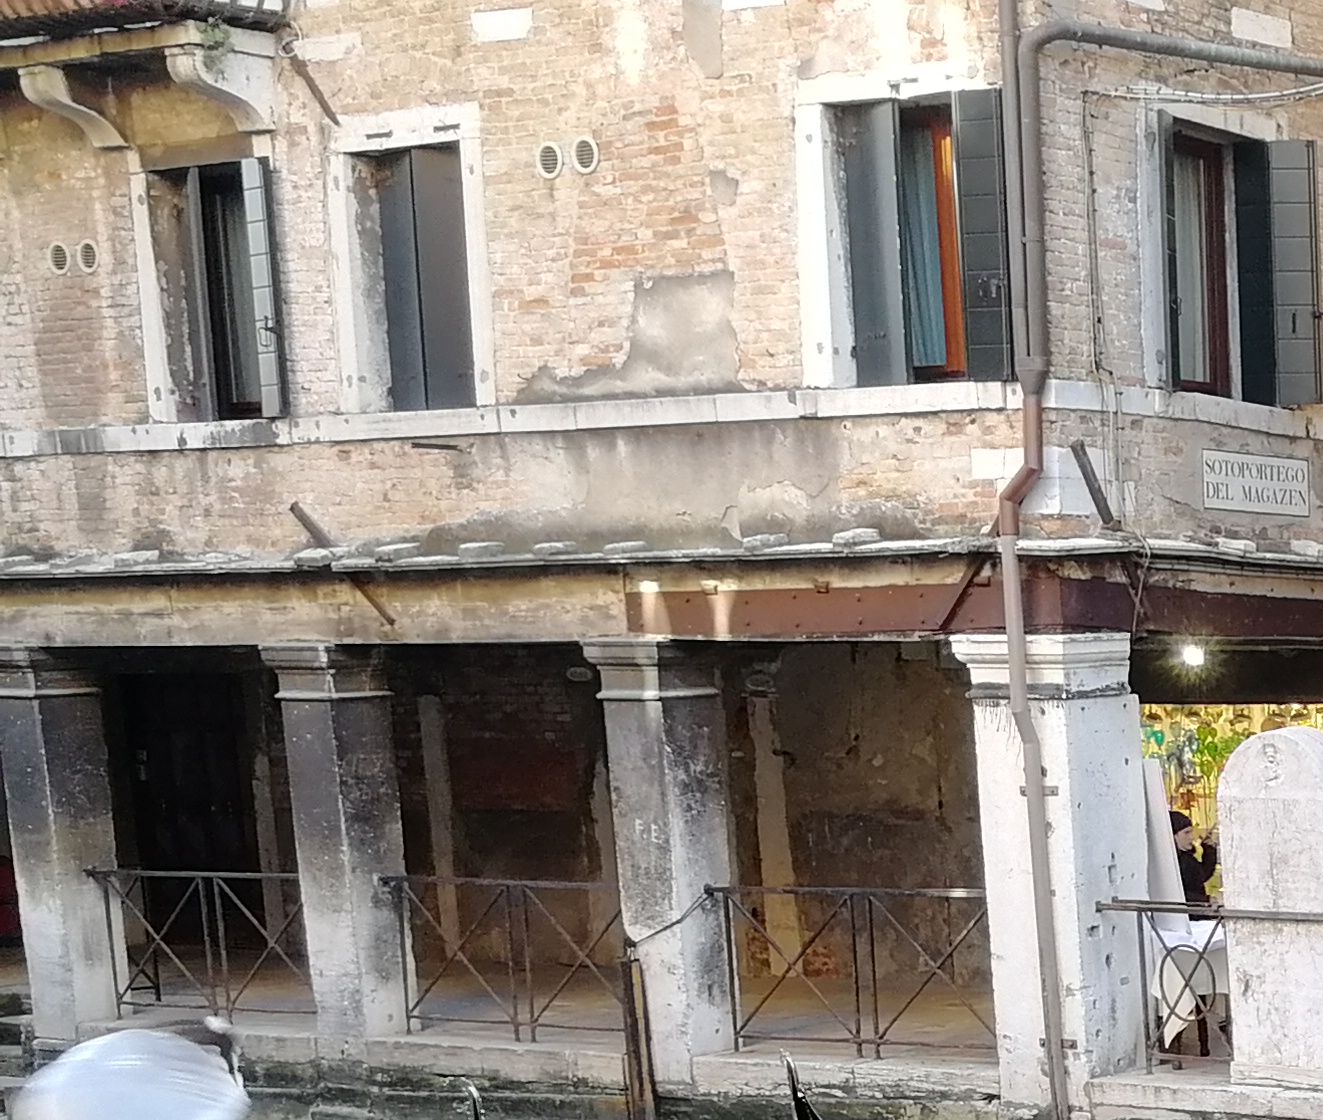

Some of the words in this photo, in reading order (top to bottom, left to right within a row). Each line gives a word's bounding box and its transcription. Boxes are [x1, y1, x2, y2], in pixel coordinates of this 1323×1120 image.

[1204, 458, 1305, 484] SOTOPORTEGO
[1205, 481, 1234, 501] DEL
[1241, 485, 1307, 507] MAGAZEN
